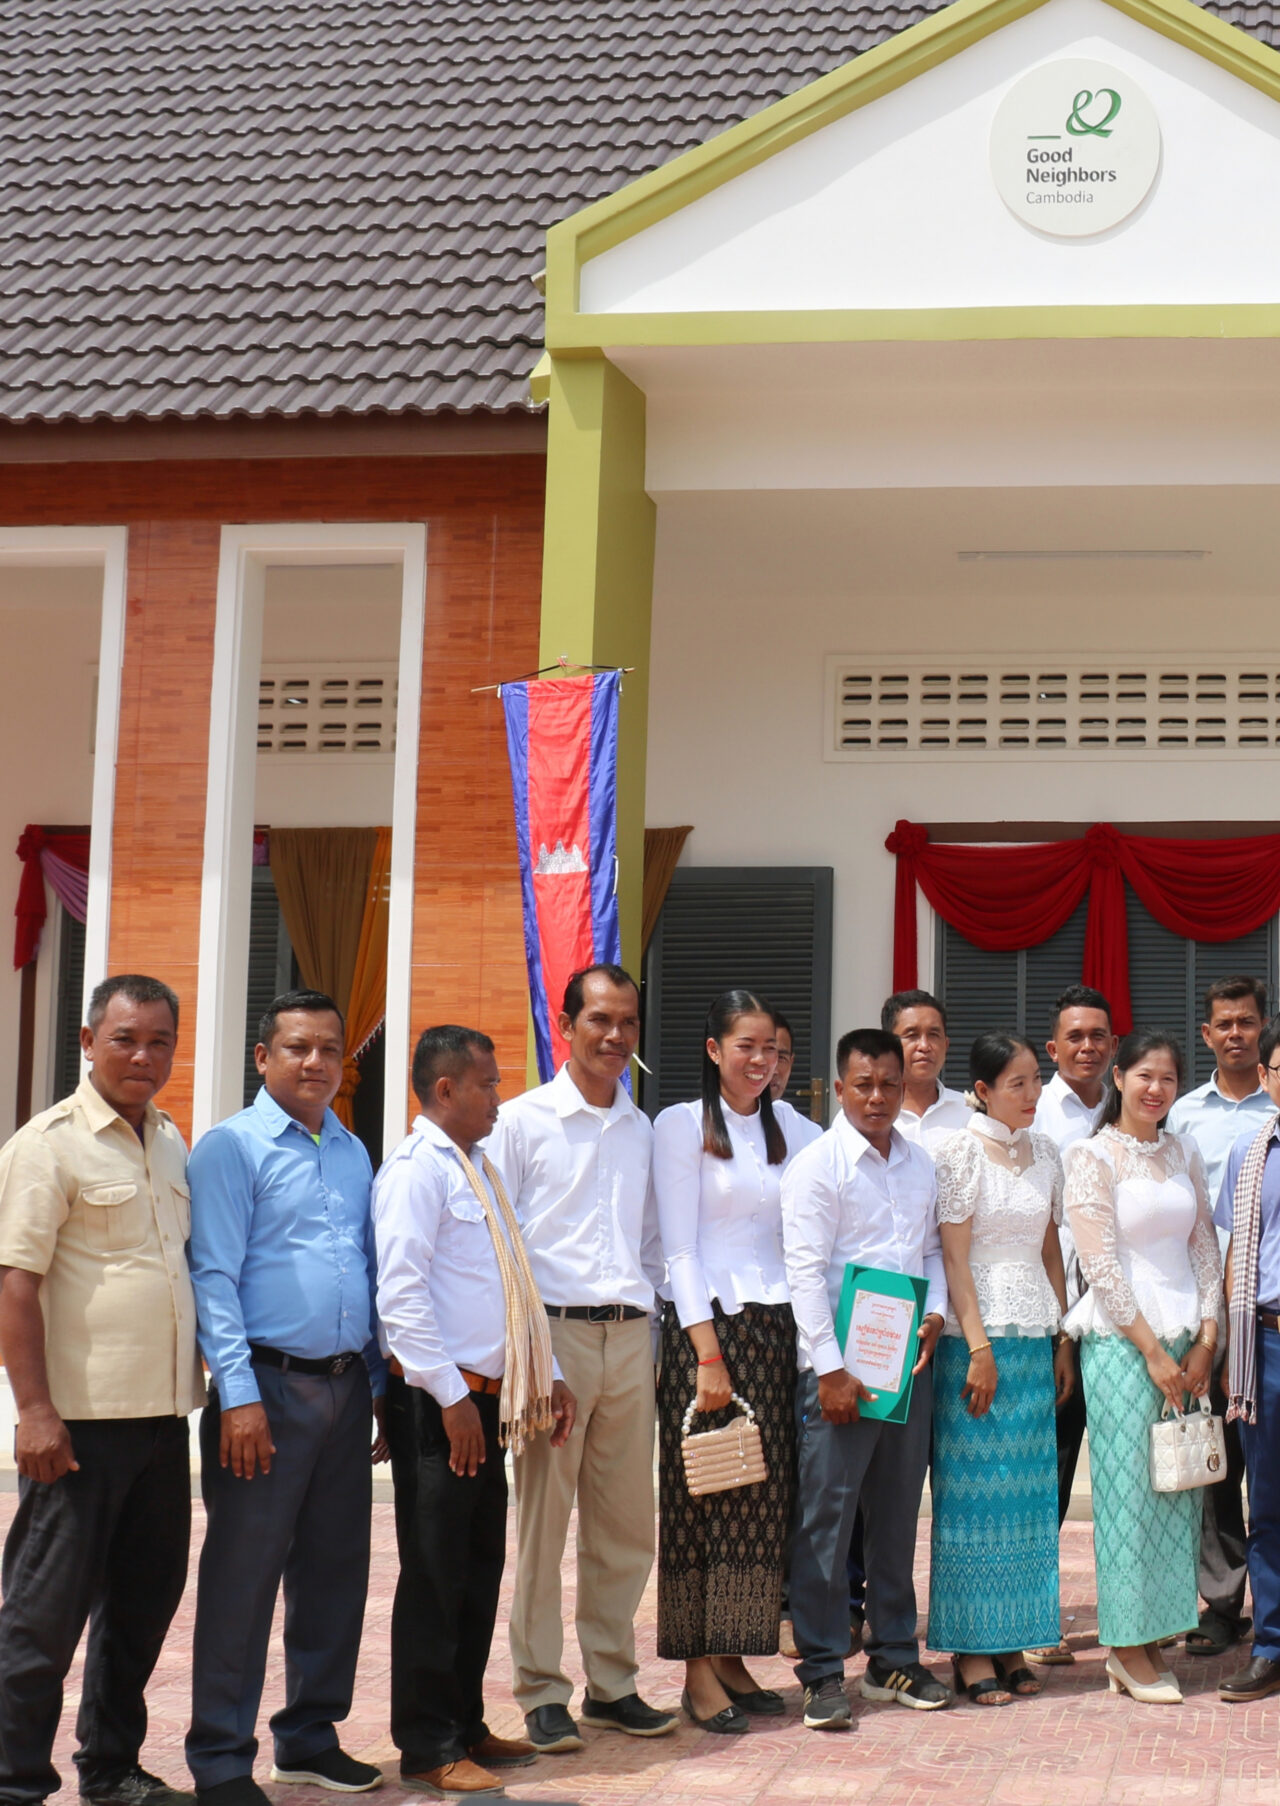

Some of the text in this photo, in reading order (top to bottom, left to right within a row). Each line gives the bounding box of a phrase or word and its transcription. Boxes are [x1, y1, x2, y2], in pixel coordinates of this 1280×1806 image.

[1026, 147, 1073, 164] Good
[1026, 167, 1117, 187] Neighbors
[1026, 191, 1094, 204] Cambodia
